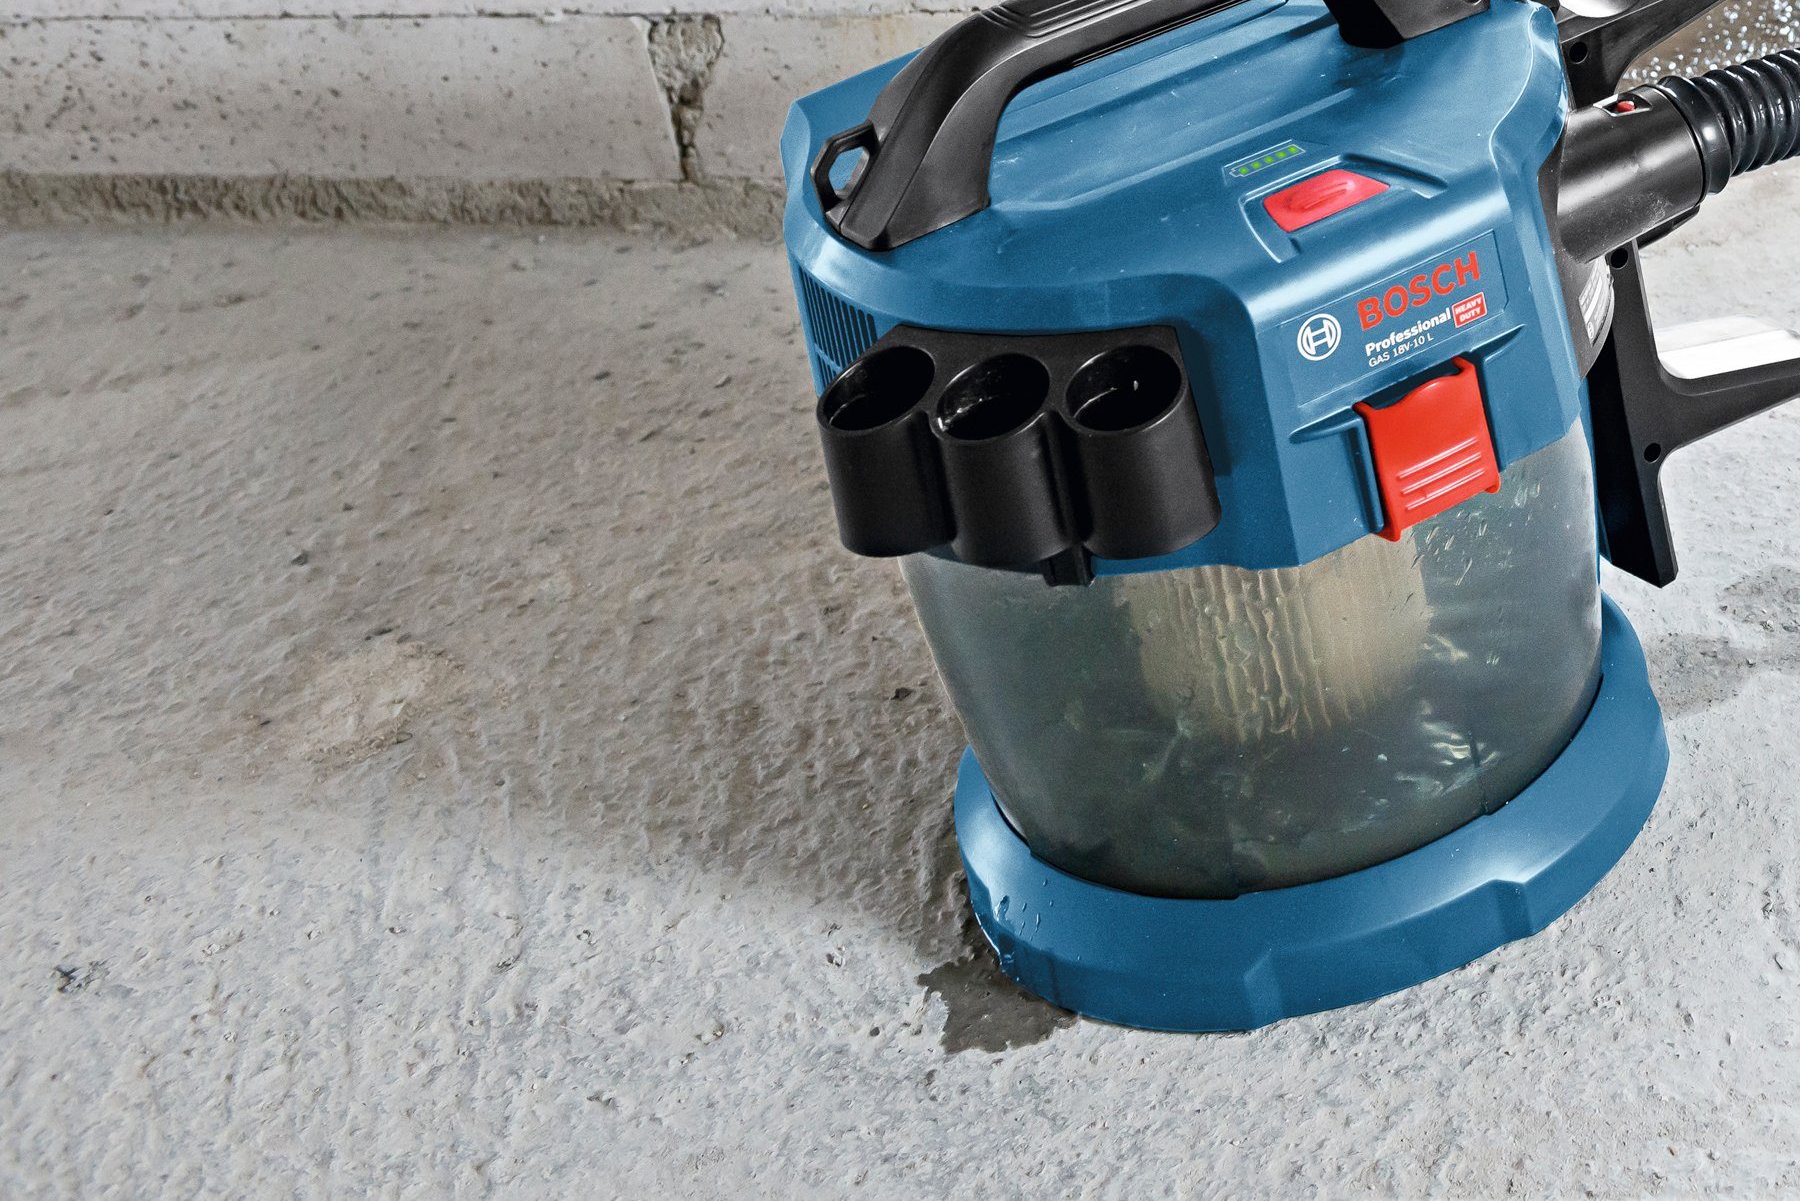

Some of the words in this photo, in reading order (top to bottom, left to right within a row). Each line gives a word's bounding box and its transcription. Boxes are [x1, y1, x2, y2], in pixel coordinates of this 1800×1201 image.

[1357, 251, 1480, 331] BOSCH
[1455, 297, 1482, 314] HEAVY
[1365, 307, 1451, 356] Professional
[1459, 307, 1481, 322] DUTY
[1368, 351, 1390, 367] GAS
[1393, 335, 1425, 357] 18V-10
[1427, 333, 1434, 341] L
